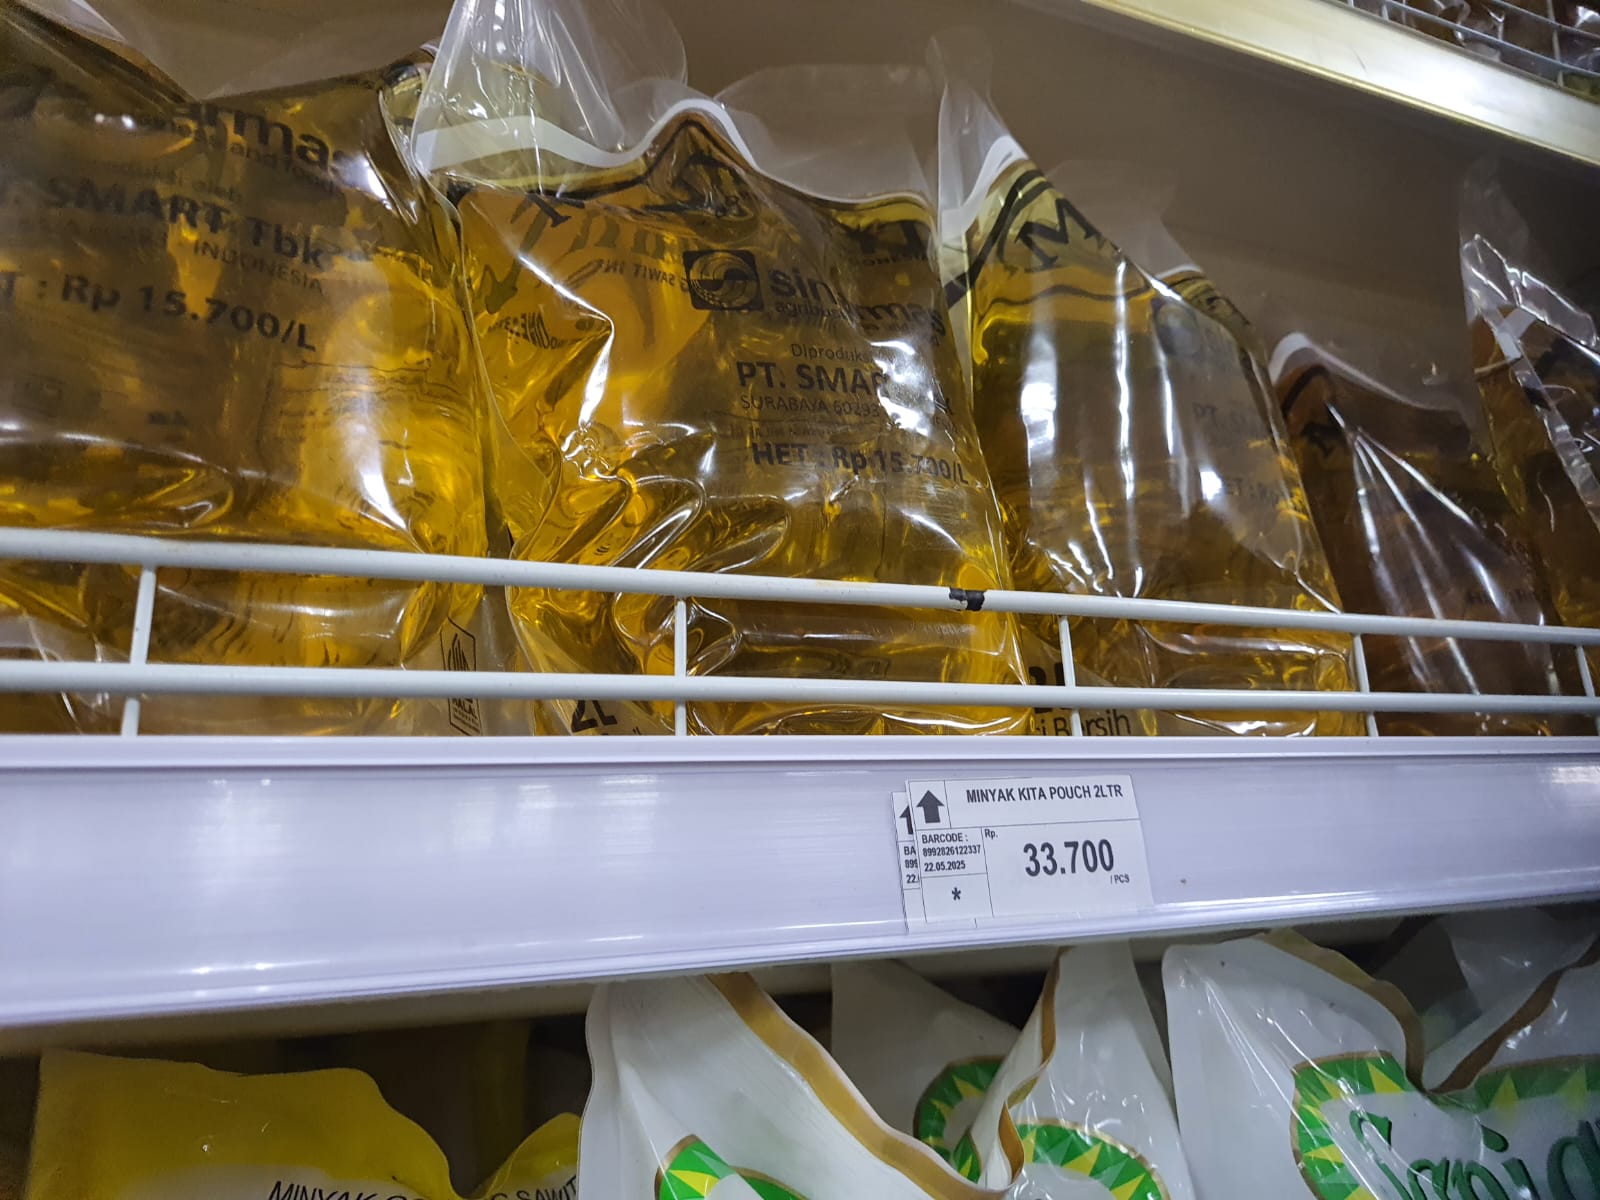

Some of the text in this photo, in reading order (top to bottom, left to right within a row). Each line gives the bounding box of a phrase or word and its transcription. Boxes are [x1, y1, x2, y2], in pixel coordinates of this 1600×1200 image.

[246, 217, 323, 269] Tbk
[194, 240, 325, 297] INDONESIA
[61, 274, 121, 313] Rp
[138, 286, 317, 352] 15.700/L
[736, 361, 786, 389] PT.
[741, 395, 828, 415] SURABAYA
[752, 442, 811, 465] HET
[831, 446, 867, 475] Rp
[966, 783, 1124, 803] MINYAK KITA POUCH 2LTR
[921, 832, 963, 844] BARCODE
[984, 828, 999, 840] Rp.
[922, 844, 981, 858] 8992826122337
[1023, 838, 1114, 877] 33.700
[924, 860, 966, 872] 22.05.2025
[1114, 873, 1130, 884] PCS
